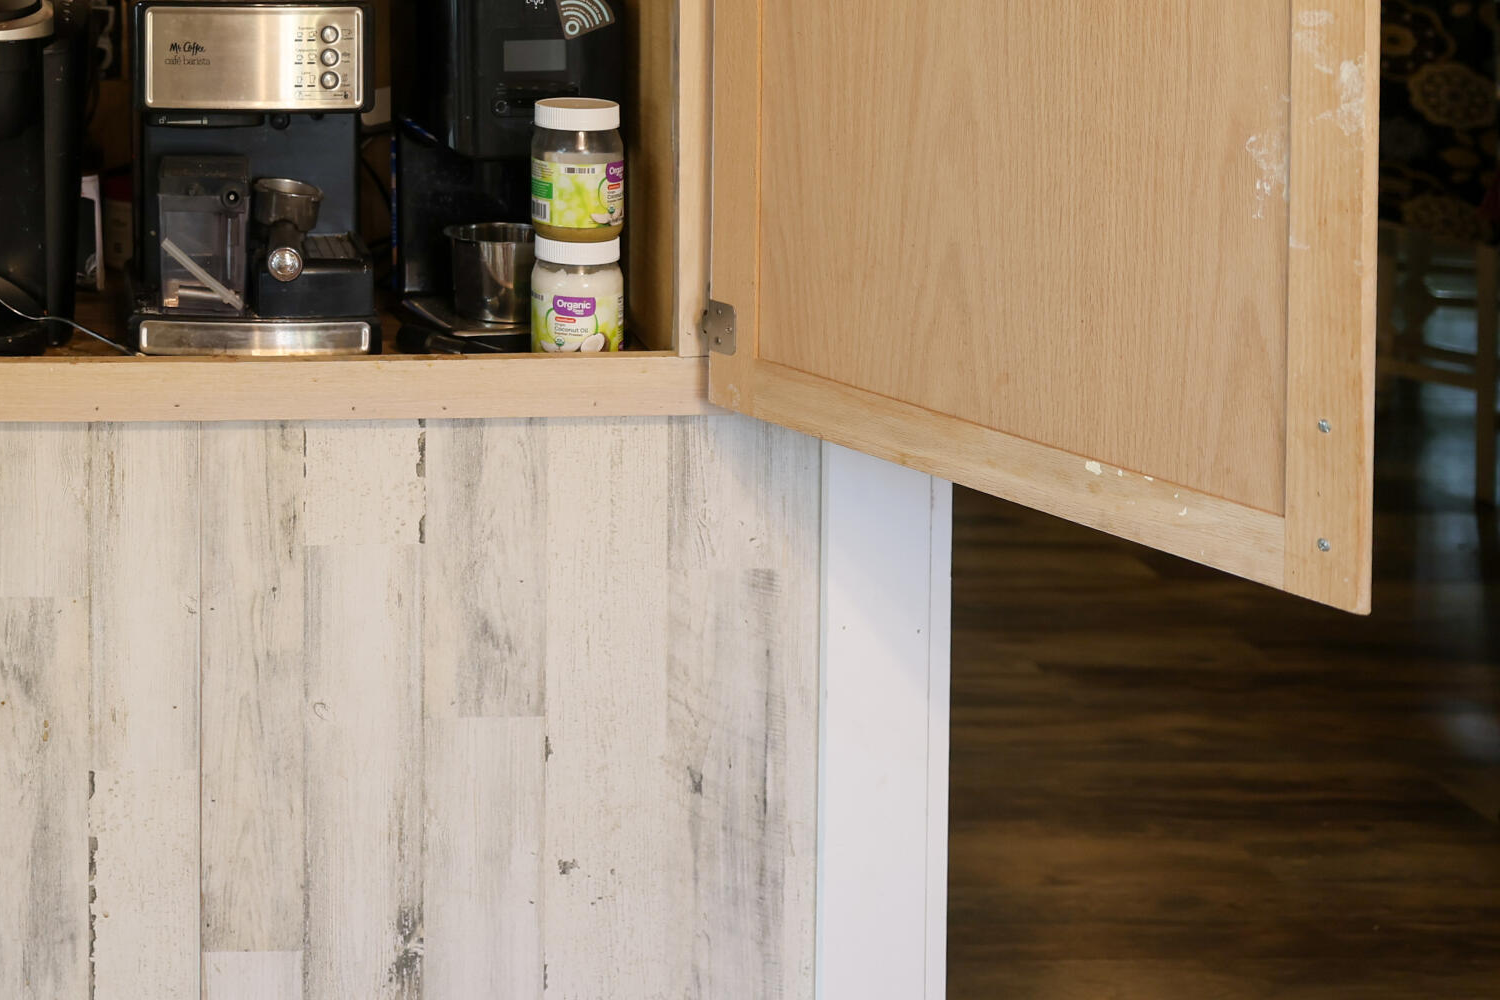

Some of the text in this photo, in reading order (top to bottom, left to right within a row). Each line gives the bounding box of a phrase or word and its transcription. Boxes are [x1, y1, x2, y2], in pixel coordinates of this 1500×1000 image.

[183, 41, 206, 56] Coffee
[183, 56, 210, 65] barista
[556, 299, 591, 311] Organic
